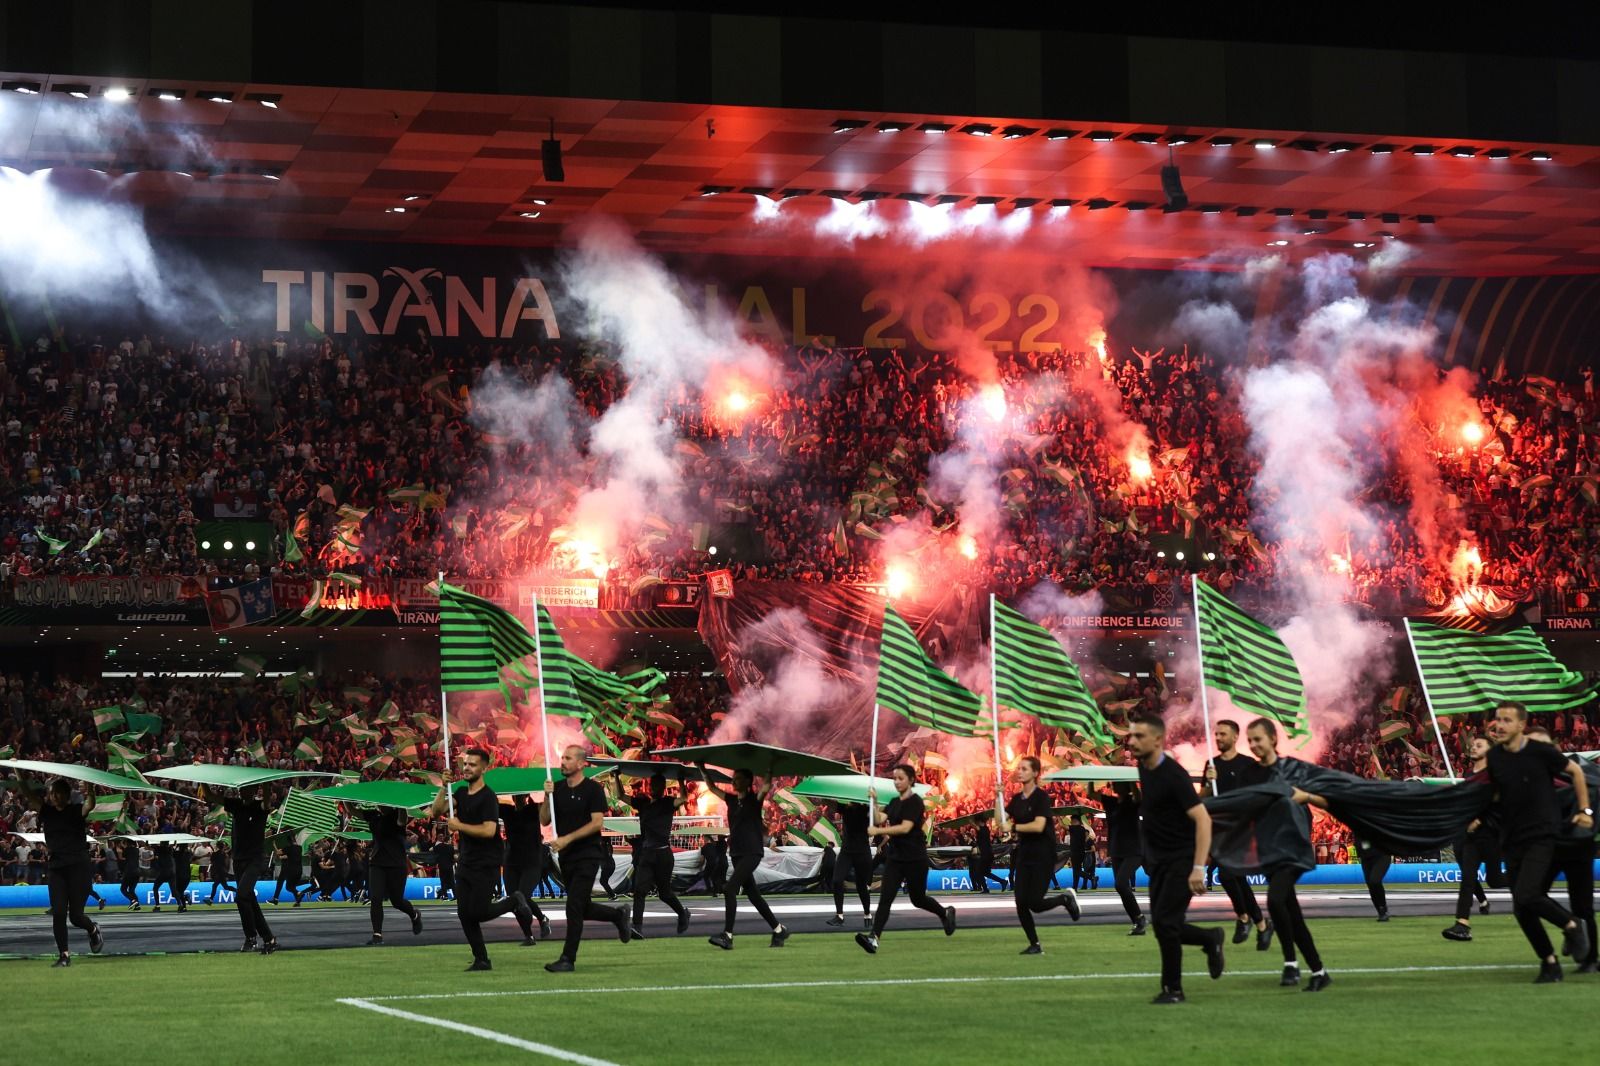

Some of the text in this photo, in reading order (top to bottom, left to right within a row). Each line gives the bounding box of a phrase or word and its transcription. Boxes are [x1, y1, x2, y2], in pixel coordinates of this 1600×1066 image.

[262, 266, 561, 339] TIRANA
[861, 288, 1062, 353] 2022
[17, 575, 72, 608] ROMA
[1137, 617, 1183, 627] LEAGUE
[1546, 617, 1592, 629] TIRANA
[1419, 870, 1462, 883] PEACE
[942, 877, 973, 890] PEA
